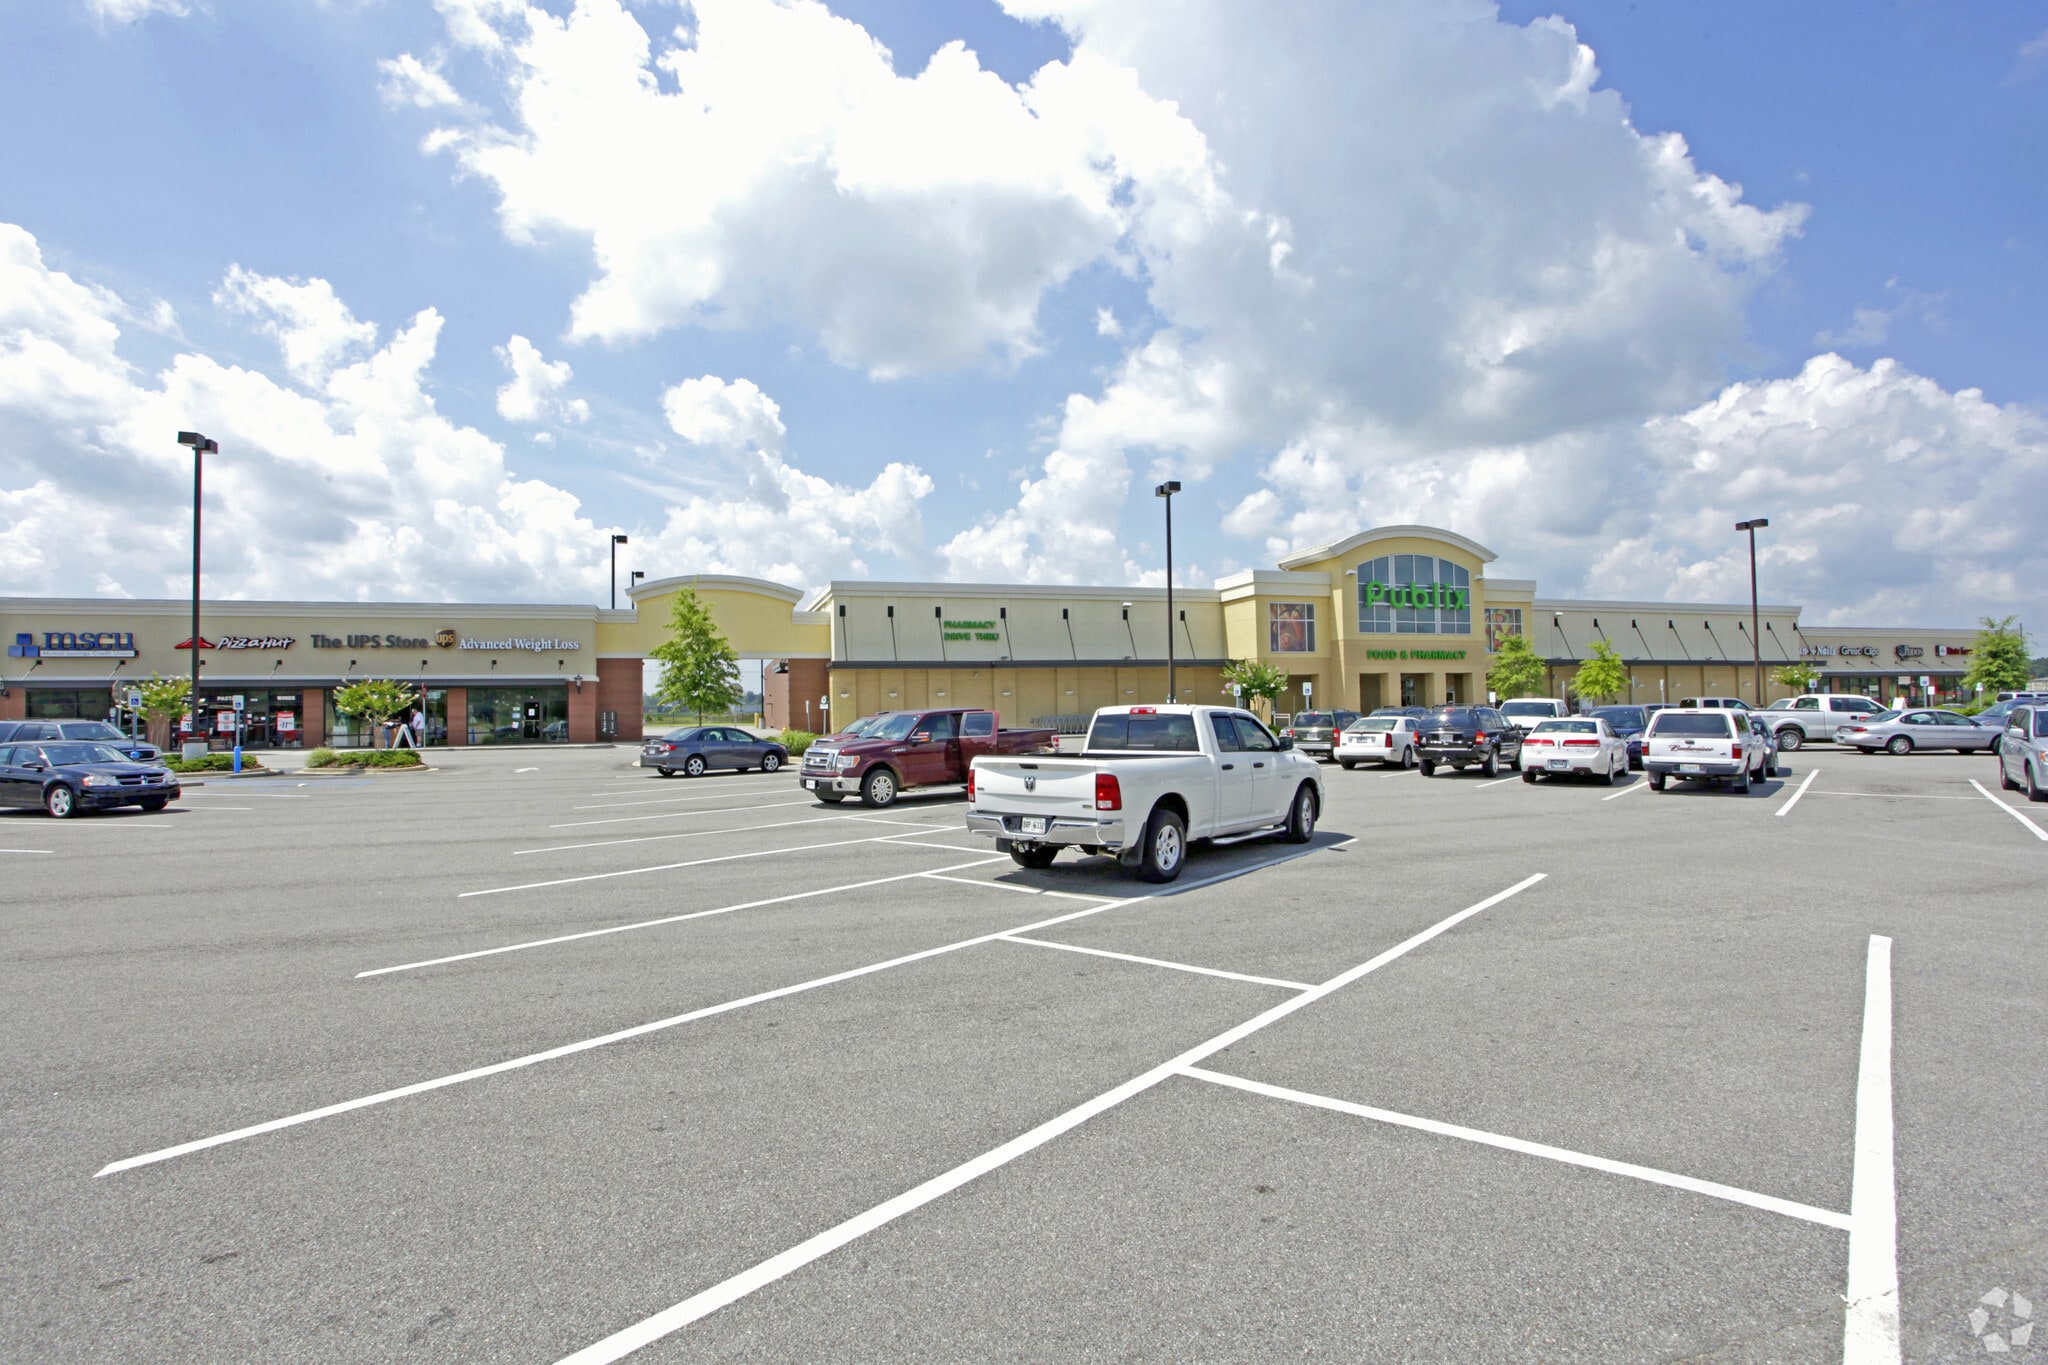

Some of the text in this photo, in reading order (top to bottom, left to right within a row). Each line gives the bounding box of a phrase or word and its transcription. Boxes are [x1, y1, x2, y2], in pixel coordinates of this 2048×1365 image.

[1366, 579, 1466, 610] Publix
[943, 620, 996, 629] PHARMACY
[42, 632, 136, 650] mscu
[217, 636, 294, 650] Pizza Hut
[311, 634, 429, 648] The UPS Store
[436, 633, 454, 647] ups
[943, 632, 1000, 641] DRIVE THRU
[459, 638, 579, 652] Advanced Weight Loss
[1367, 649, 1466, 660] FOOD & PHARMACY
